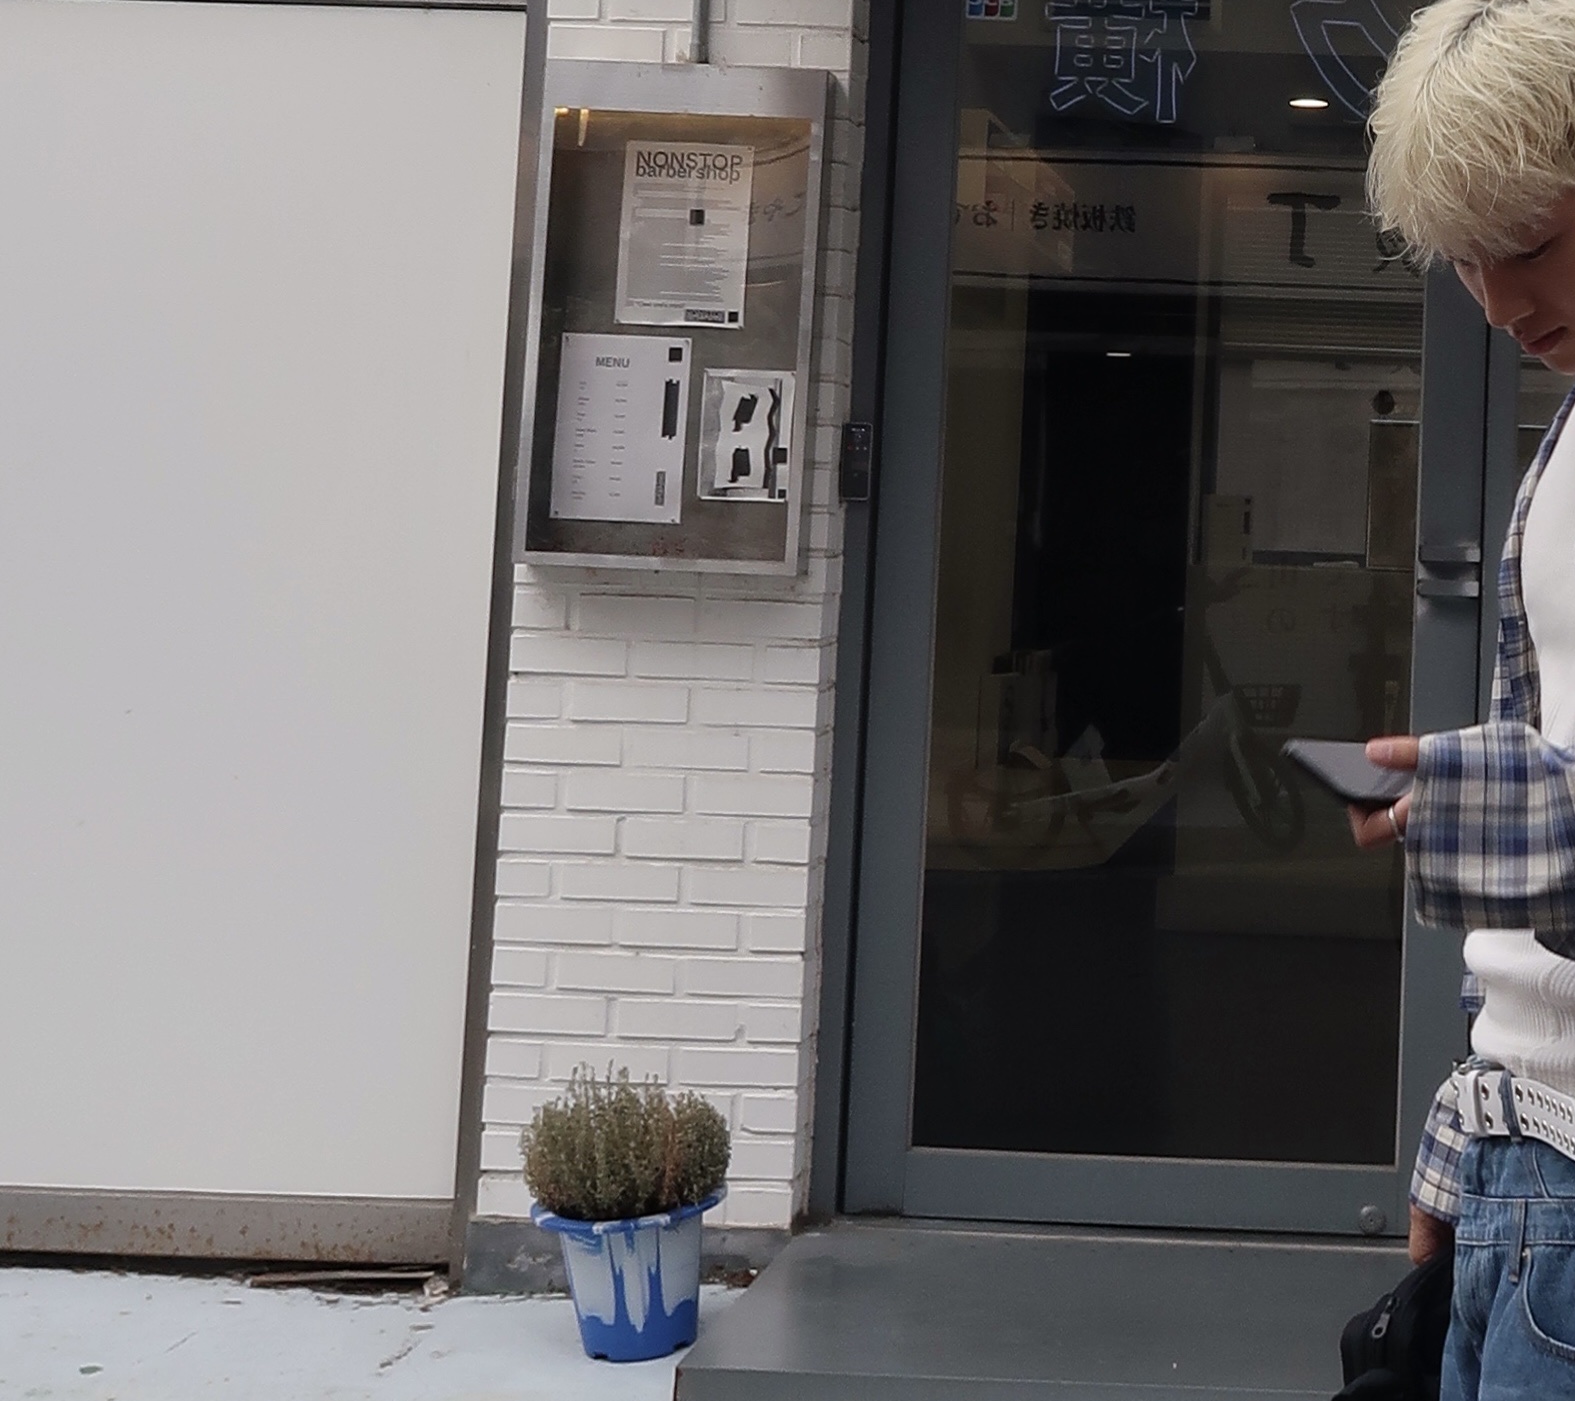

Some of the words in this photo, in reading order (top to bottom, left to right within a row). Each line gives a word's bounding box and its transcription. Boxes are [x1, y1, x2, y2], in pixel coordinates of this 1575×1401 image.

[636, 151, 743, 171] NONSTOP
[635, 163, 740, 185] barbershop
[595, 356, 630, 368] MENU
